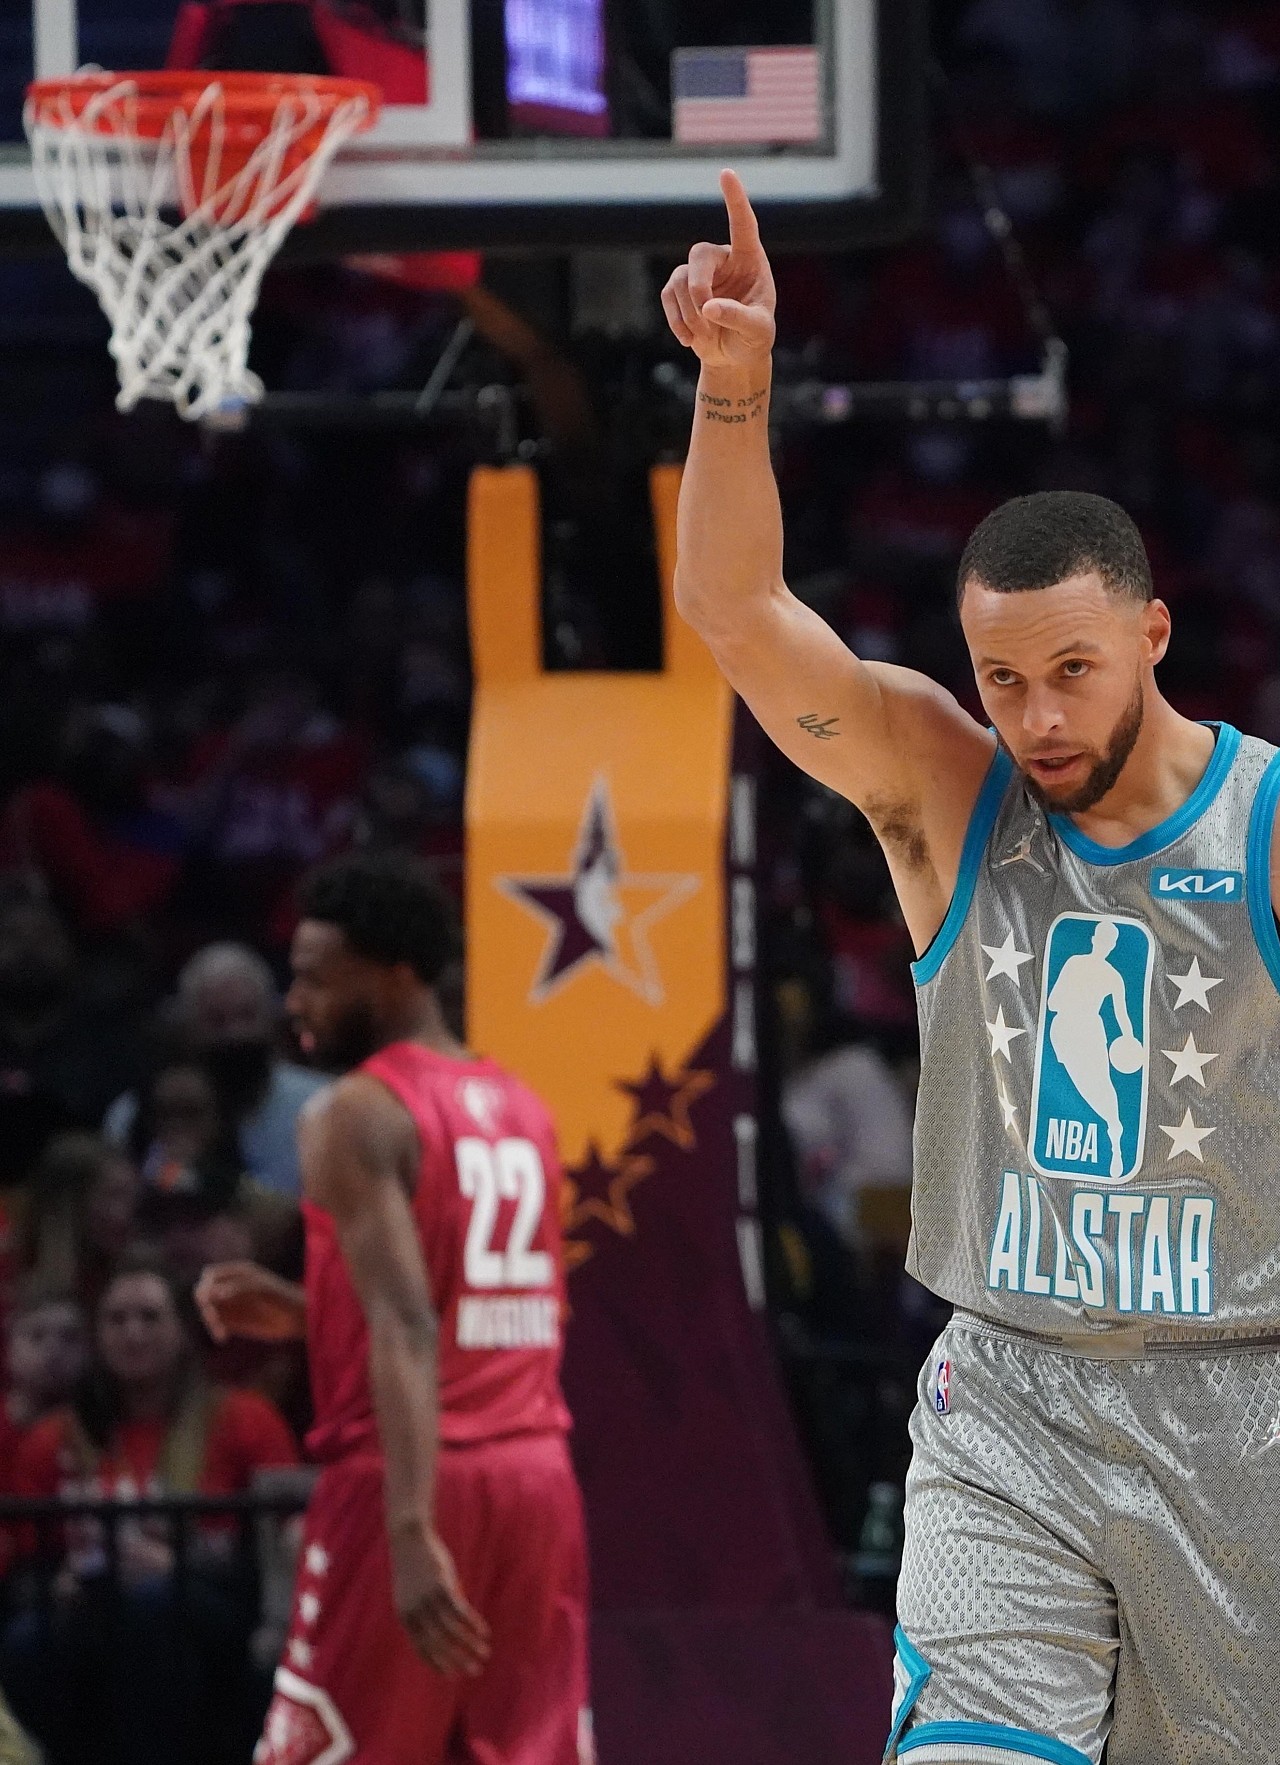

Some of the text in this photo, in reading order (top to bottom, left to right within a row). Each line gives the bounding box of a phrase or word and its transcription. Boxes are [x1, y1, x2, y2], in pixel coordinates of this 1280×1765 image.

[1159, 873, 1235, 895] KIA
[1045, 1117, 1098, 1164] NBA
[455, 1136, 555, 1289] 22
